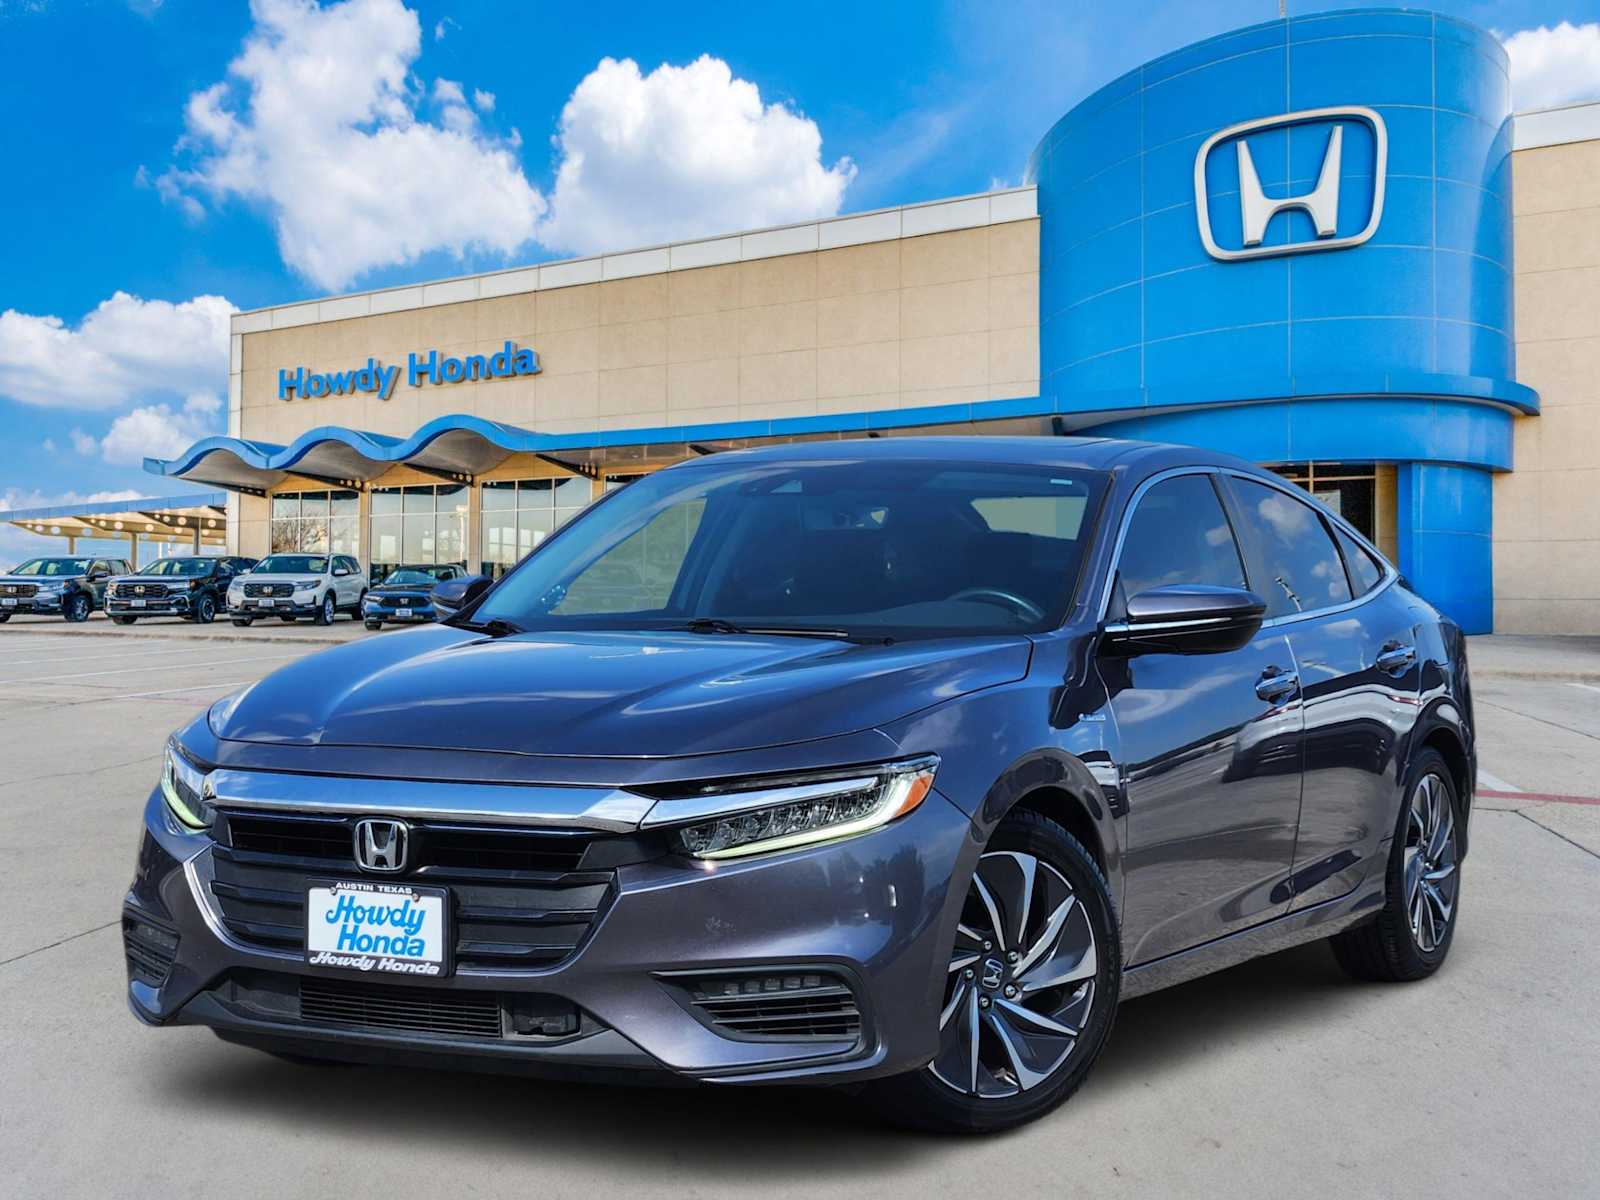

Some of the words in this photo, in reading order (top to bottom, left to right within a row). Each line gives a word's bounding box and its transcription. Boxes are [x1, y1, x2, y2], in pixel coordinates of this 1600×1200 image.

[278, 358, 401, 401] Howdy
[408, 340, 542, 387] Honda
[335, 882, 374, 891] AUSTIN
[378, 886, 413, 895] TEXAS
[325, 895, 426, 935] Howdy
[336, 924, 426, 957] Honda
[309, 951, 377, 971] Howdy
[378, 957, 440, 975] Honda
